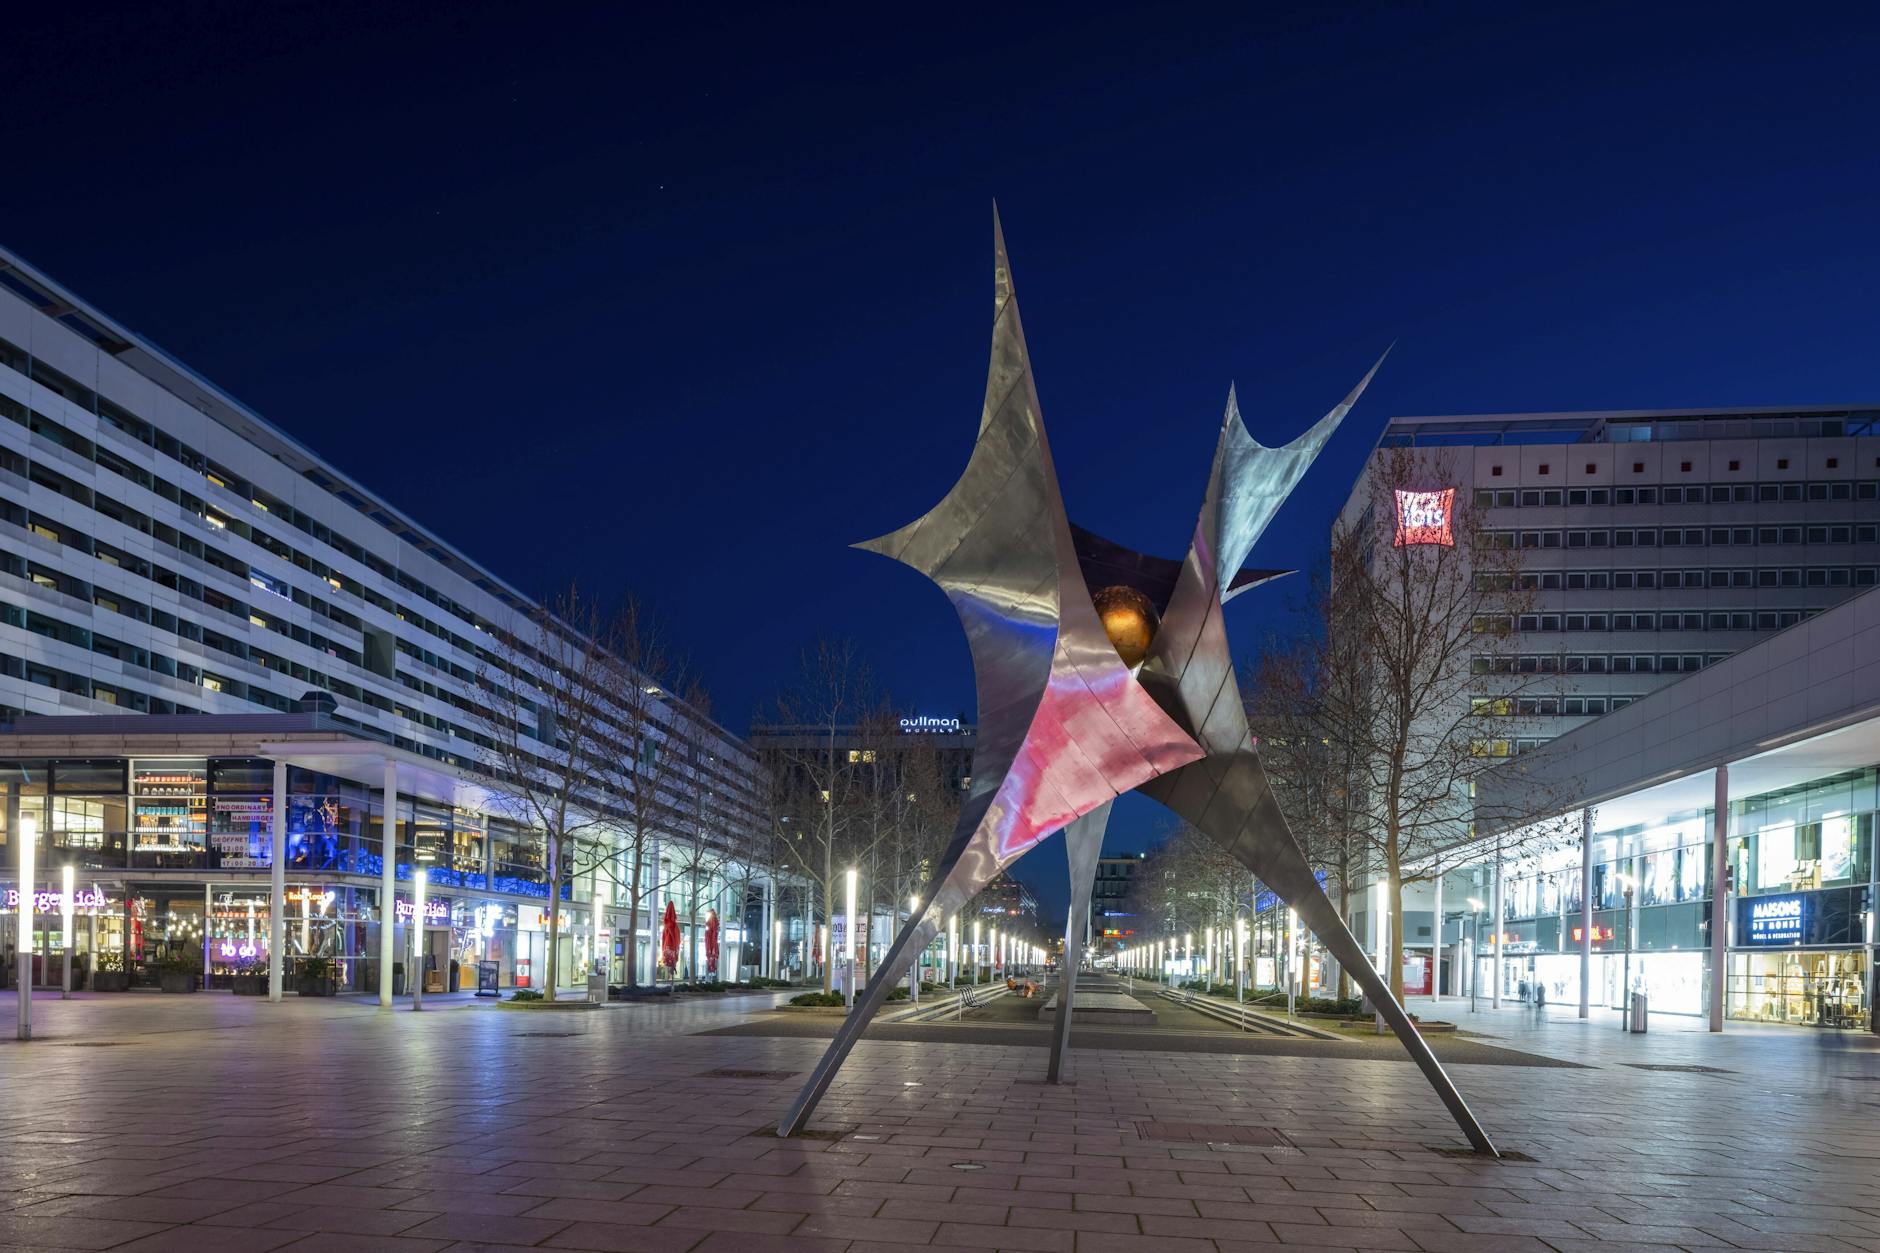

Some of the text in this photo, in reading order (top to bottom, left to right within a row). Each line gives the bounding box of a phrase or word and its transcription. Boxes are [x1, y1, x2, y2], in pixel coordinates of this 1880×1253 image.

[900, 716, 959, 729] pullman
[1753, 900, 1801, 918] MAISONS
[1753, 920, 1800, 931] DU MONDE
